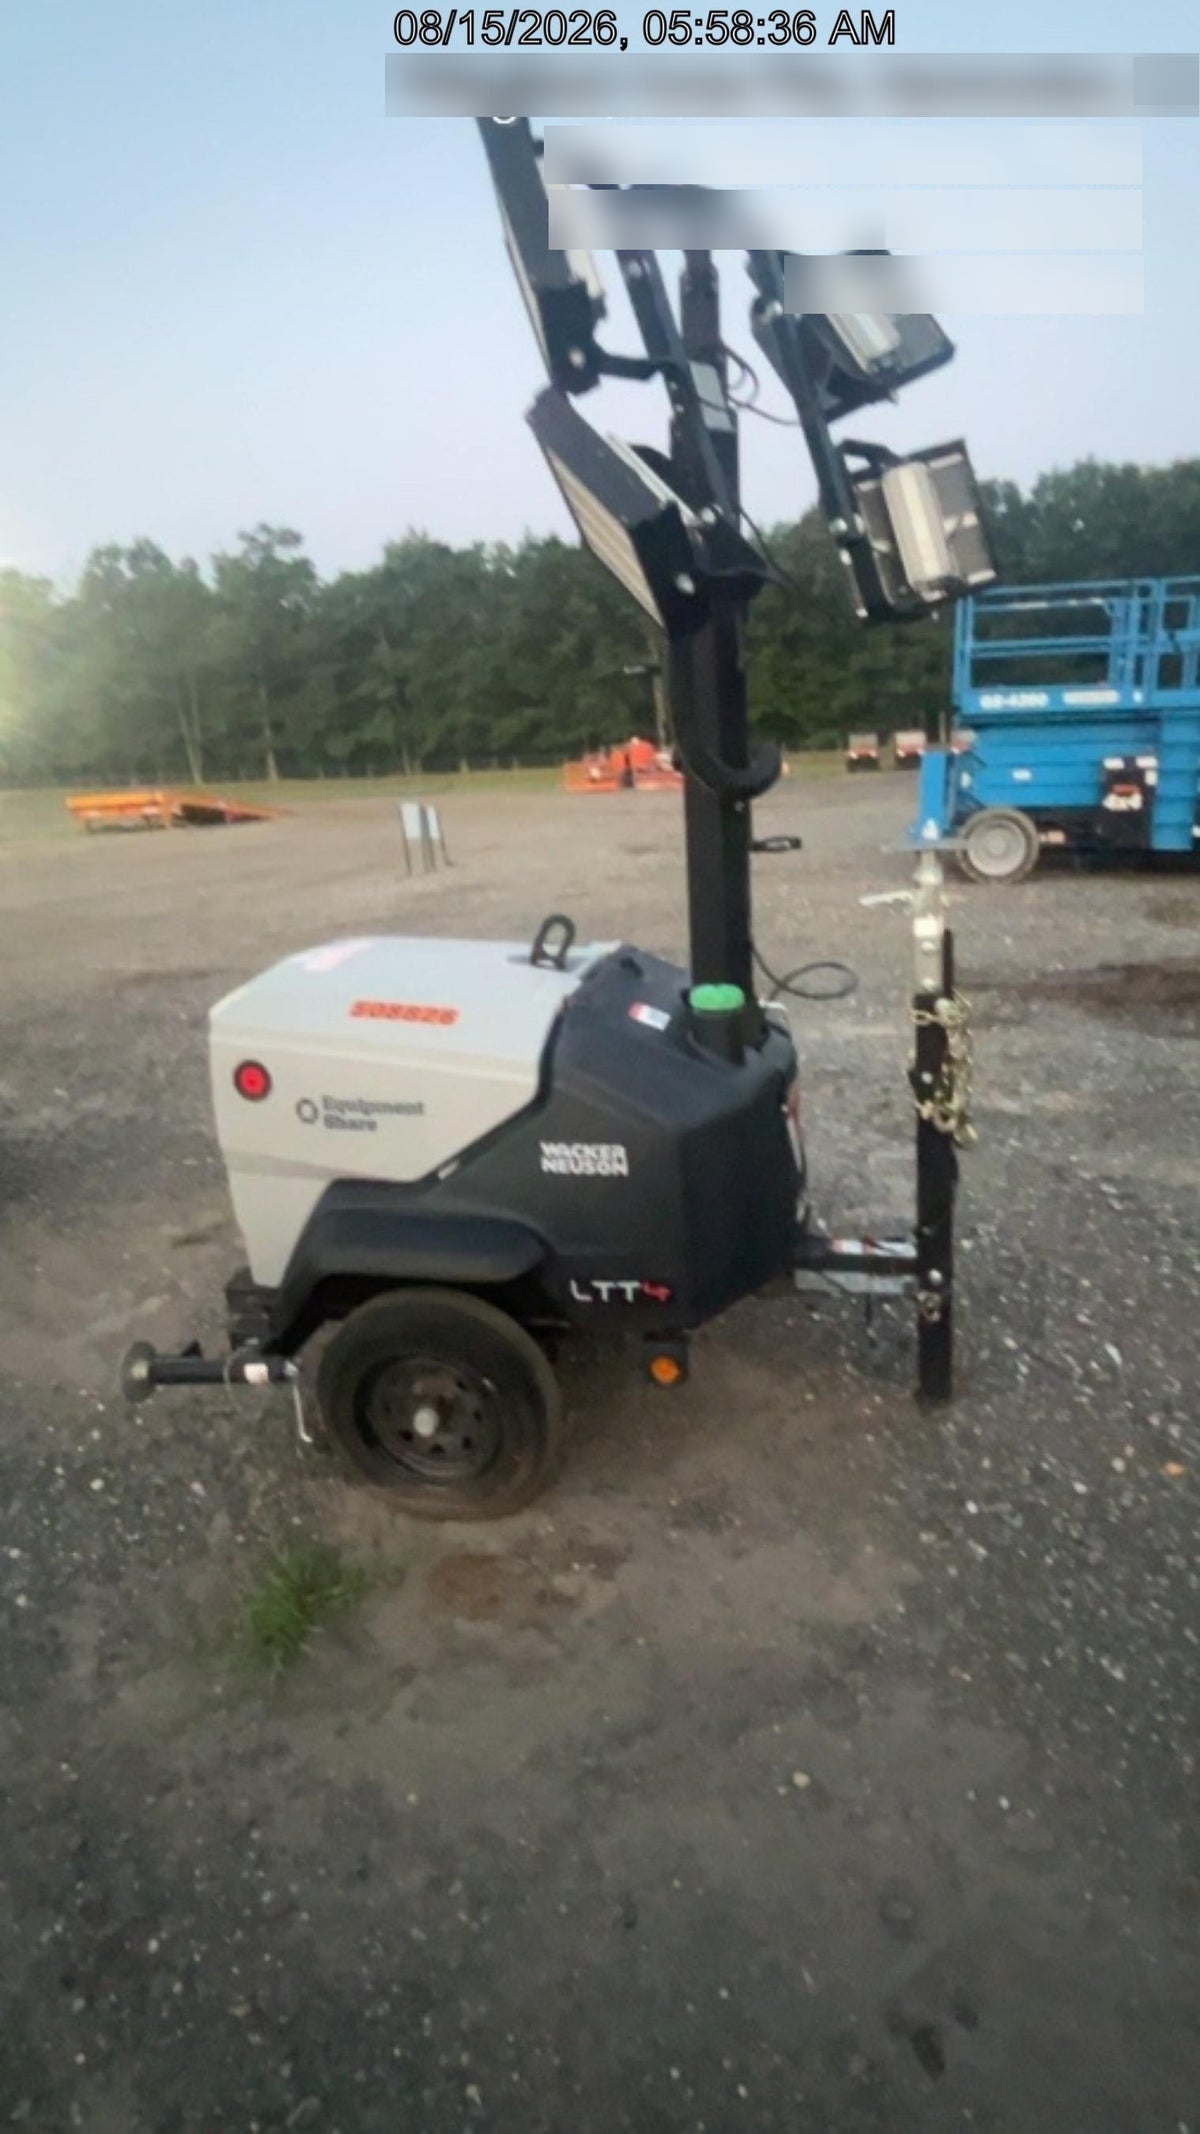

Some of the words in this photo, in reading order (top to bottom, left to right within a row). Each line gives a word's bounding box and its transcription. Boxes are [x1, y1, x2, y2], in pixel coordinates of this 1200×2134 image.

[321, 1095, 424, 1117] Equipment
[323, 1114, 378, 1131] Share
[540, 1142, 626, 1160] WACKER
[541, 1158, 629, 1177] NEUSON
[569, 1278, 672, 1303] LTT4
